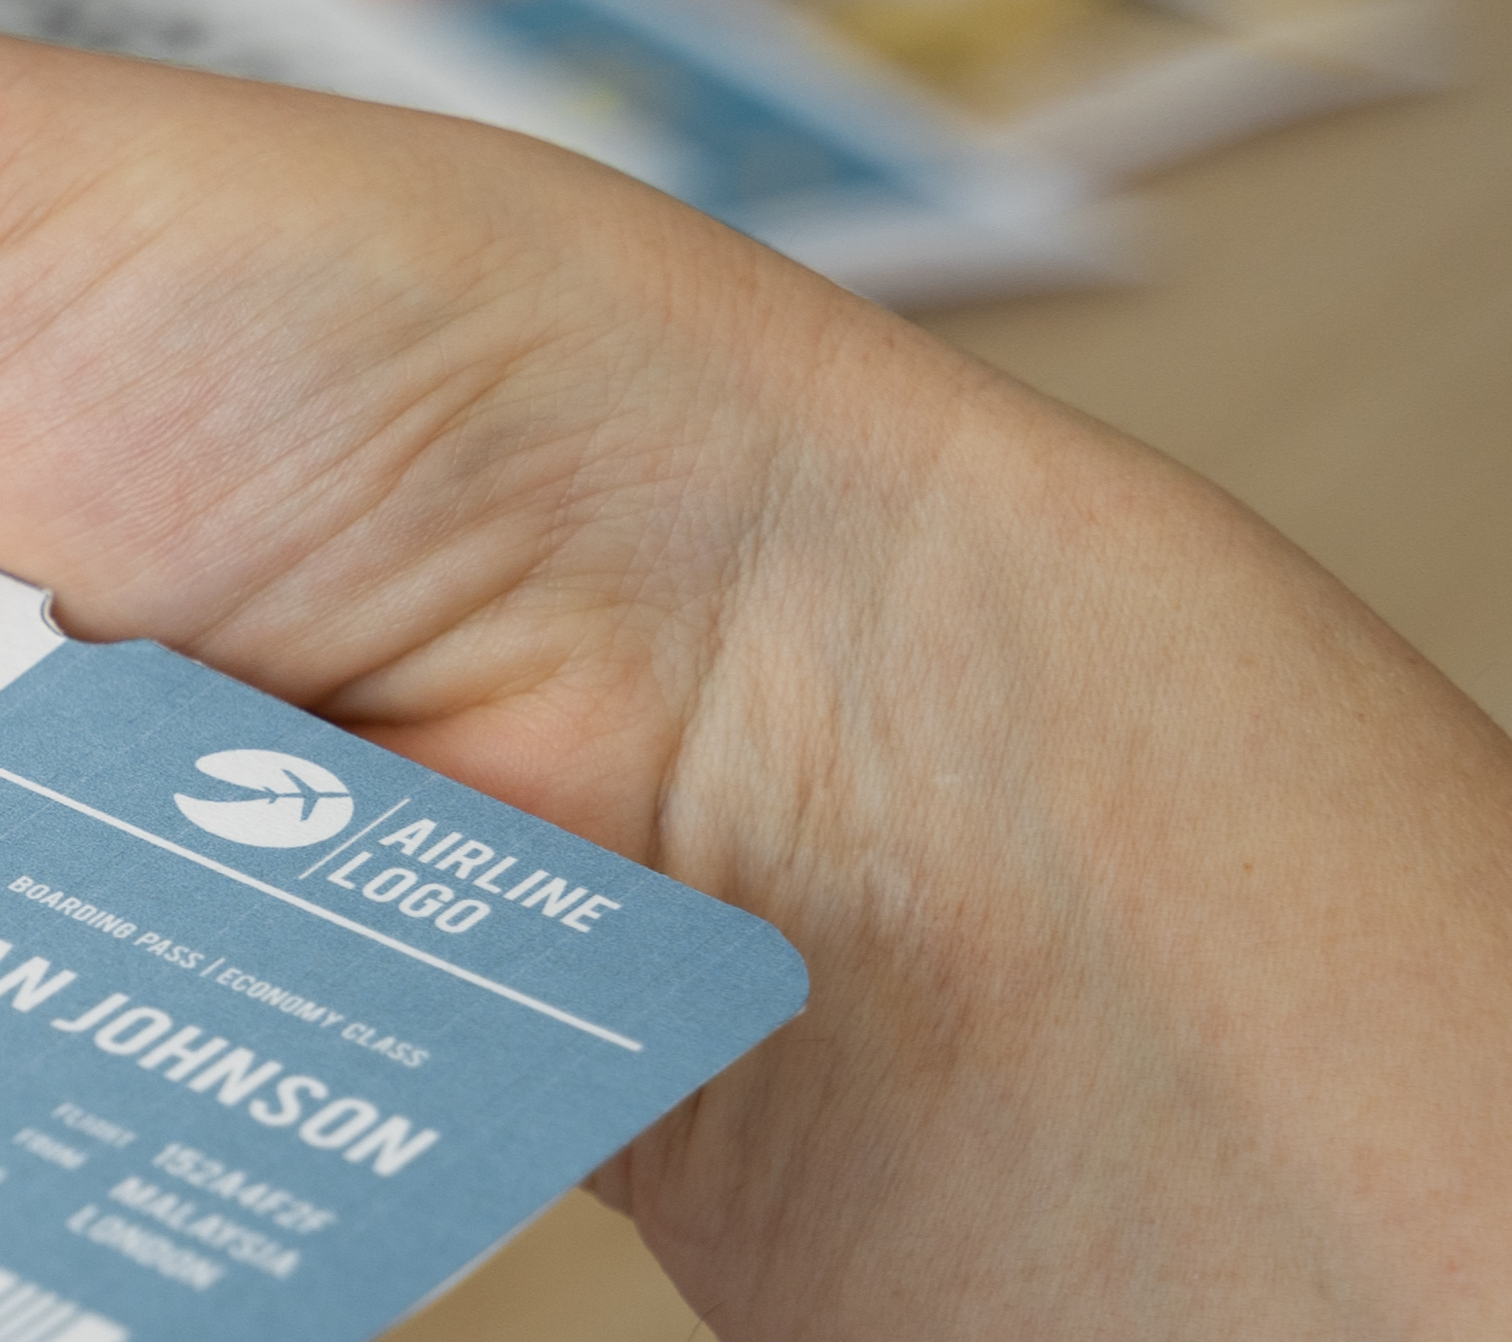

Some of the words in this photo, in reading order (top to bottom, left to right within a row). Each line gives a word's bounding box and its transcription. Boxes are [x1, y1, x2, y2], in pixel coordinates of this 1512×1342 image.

[326, 850, 492, 936] LOGO
[378, 816, 622, 934] AIRLINE
[7, 874, 138, 950] BOARDING
[132, 931, 205, 973] PASS
[216, 967, 344, 1032] ECONOMY
[342, 1021, 431, 1069] CLASS
[52, 991, 441, 1179] JOHNSON
